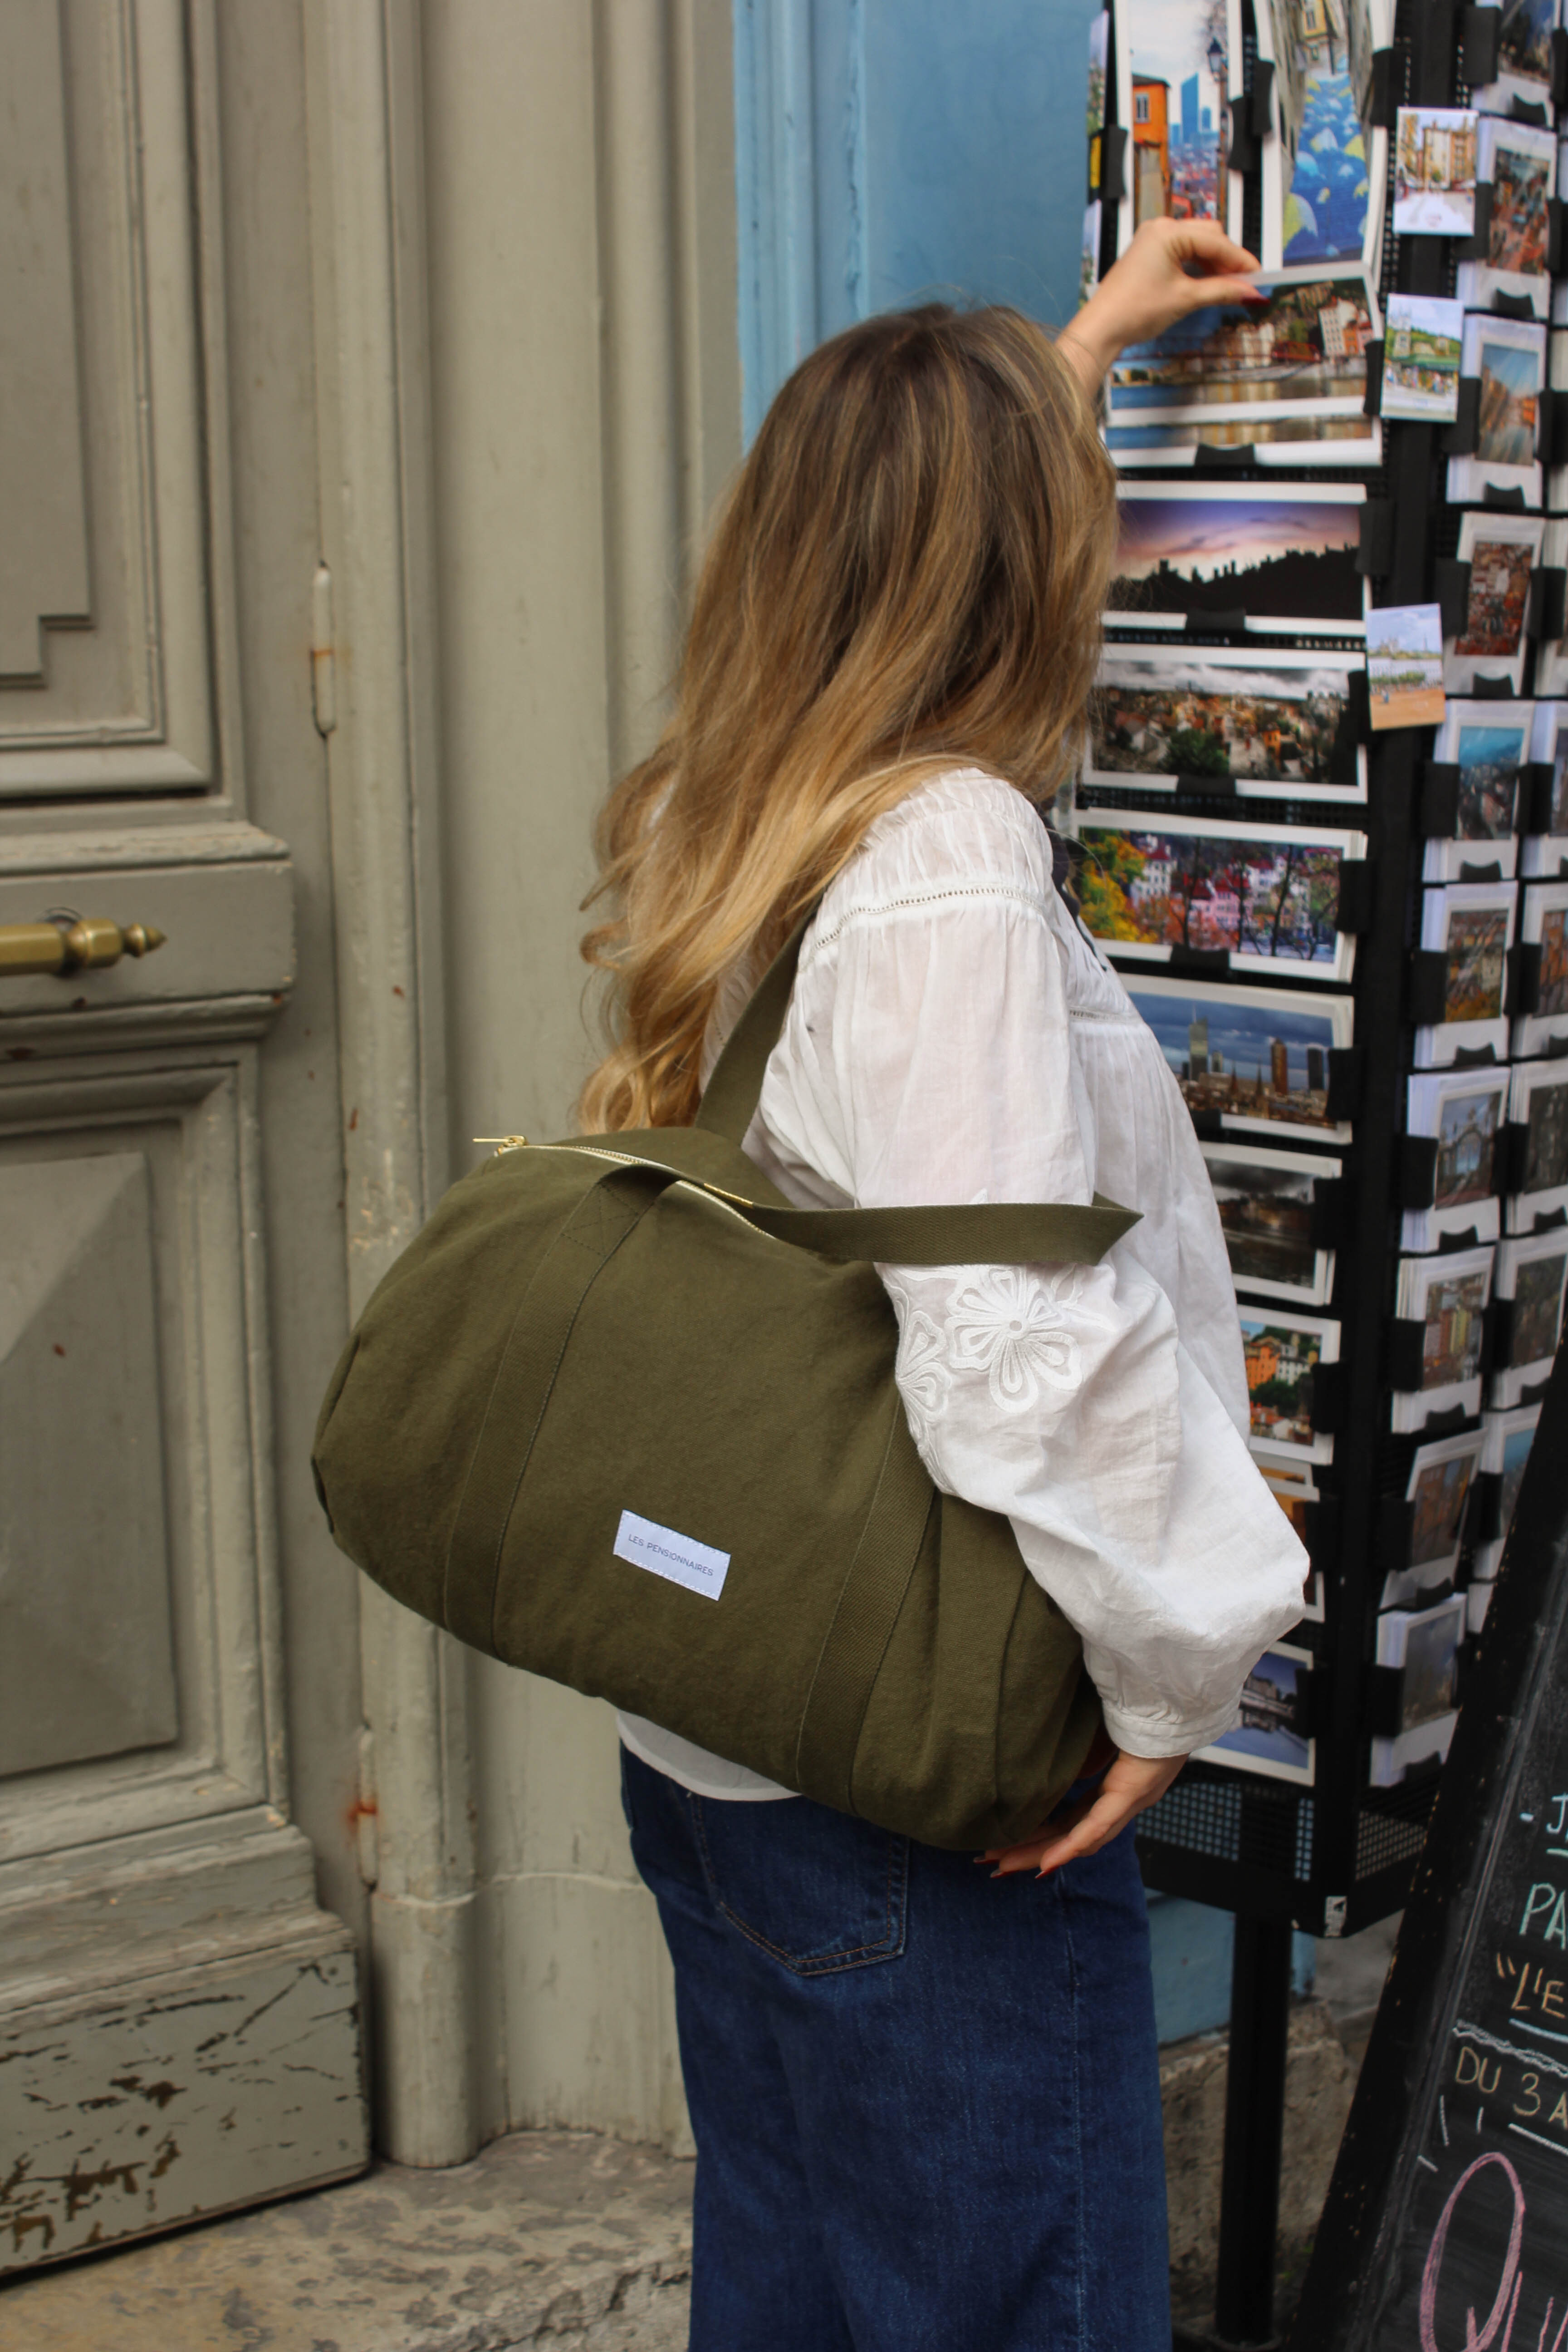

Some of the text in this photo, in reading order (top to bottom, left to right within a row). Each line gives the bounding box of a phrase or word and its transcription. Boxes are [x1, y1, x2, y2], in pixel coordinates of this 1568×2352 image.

[628, 1534, 713, 1576] LES PENSIONNAIRES
[1546, 1793, 1568, 1840] J
[1519, 1883, 1568, 1950] PA
[1455, 2046, 1501, 2093] DU
[1513, 2073, 1541, 2116] 3
